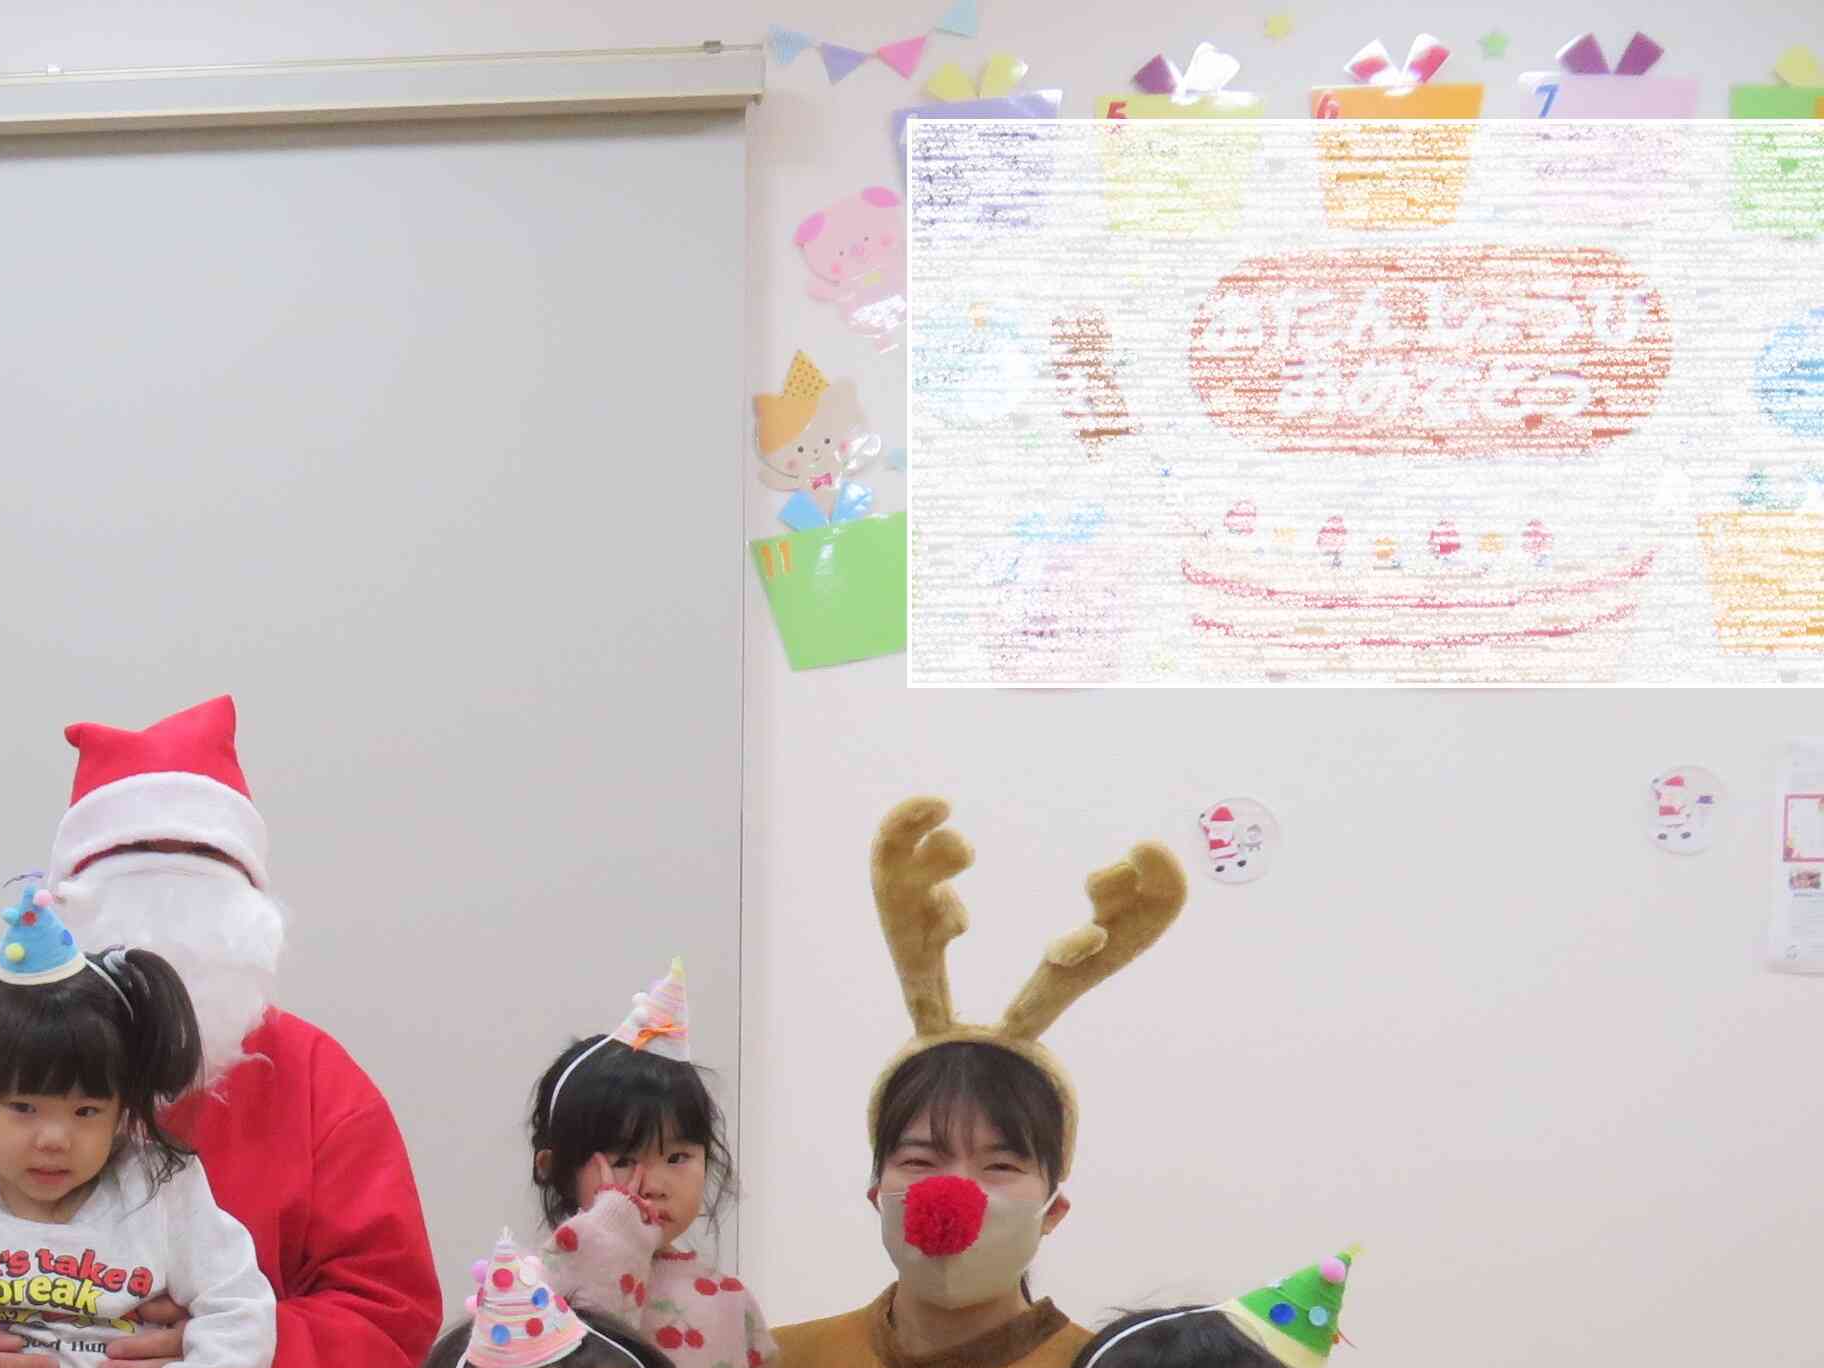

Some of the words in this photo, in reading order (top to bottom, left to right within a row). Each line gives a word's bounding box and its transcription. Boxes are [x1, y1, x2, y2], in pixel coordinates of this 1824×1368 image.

[1535, 84, 1560, 119] 7
[35, 1248, 127, 1291] take
[128, 1265, 154, 1297] a
